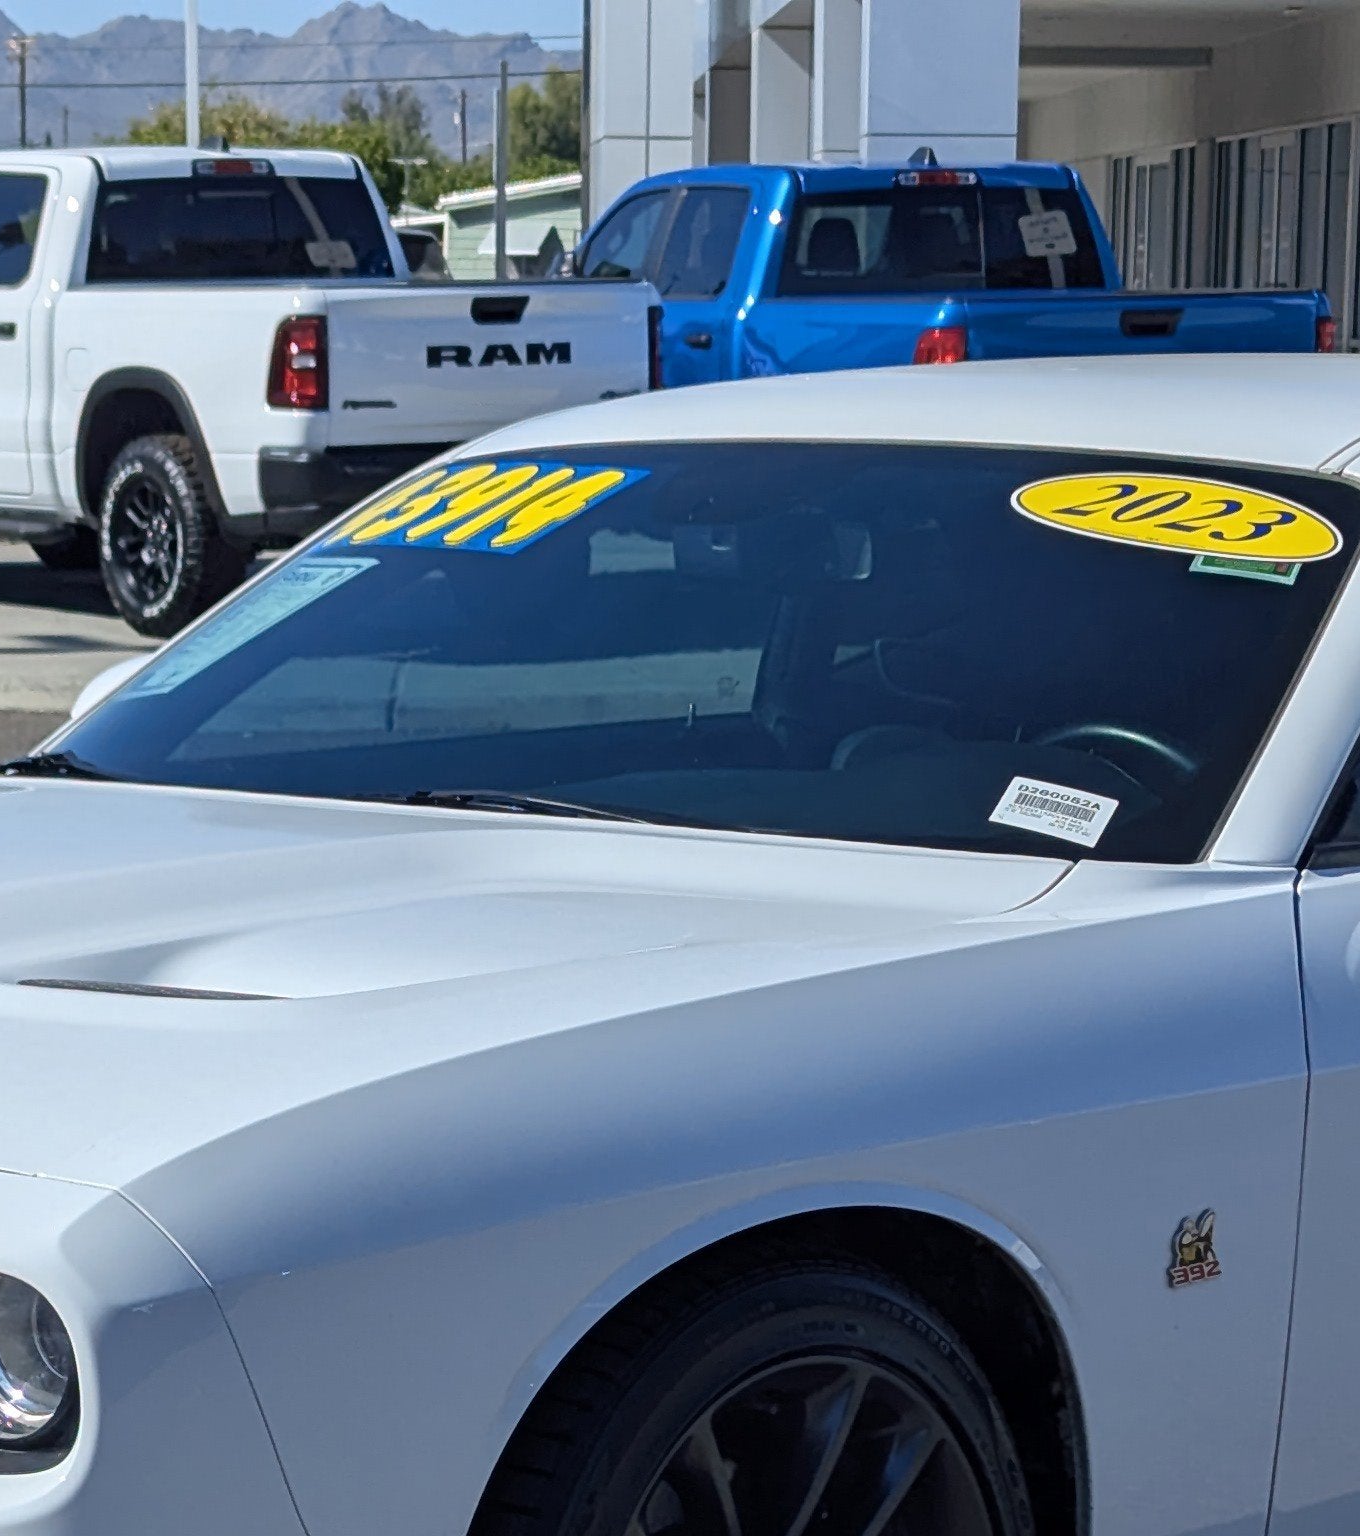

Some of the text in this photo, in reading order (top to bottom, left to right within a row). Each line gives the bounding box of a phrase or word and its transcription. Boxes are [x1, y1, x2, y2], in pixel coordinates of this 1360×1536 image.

[426, 342, 571, 368] RAM
[1051, 483, 1297, 542] 2023
[1173, 1260, 1222, 1286] 392
